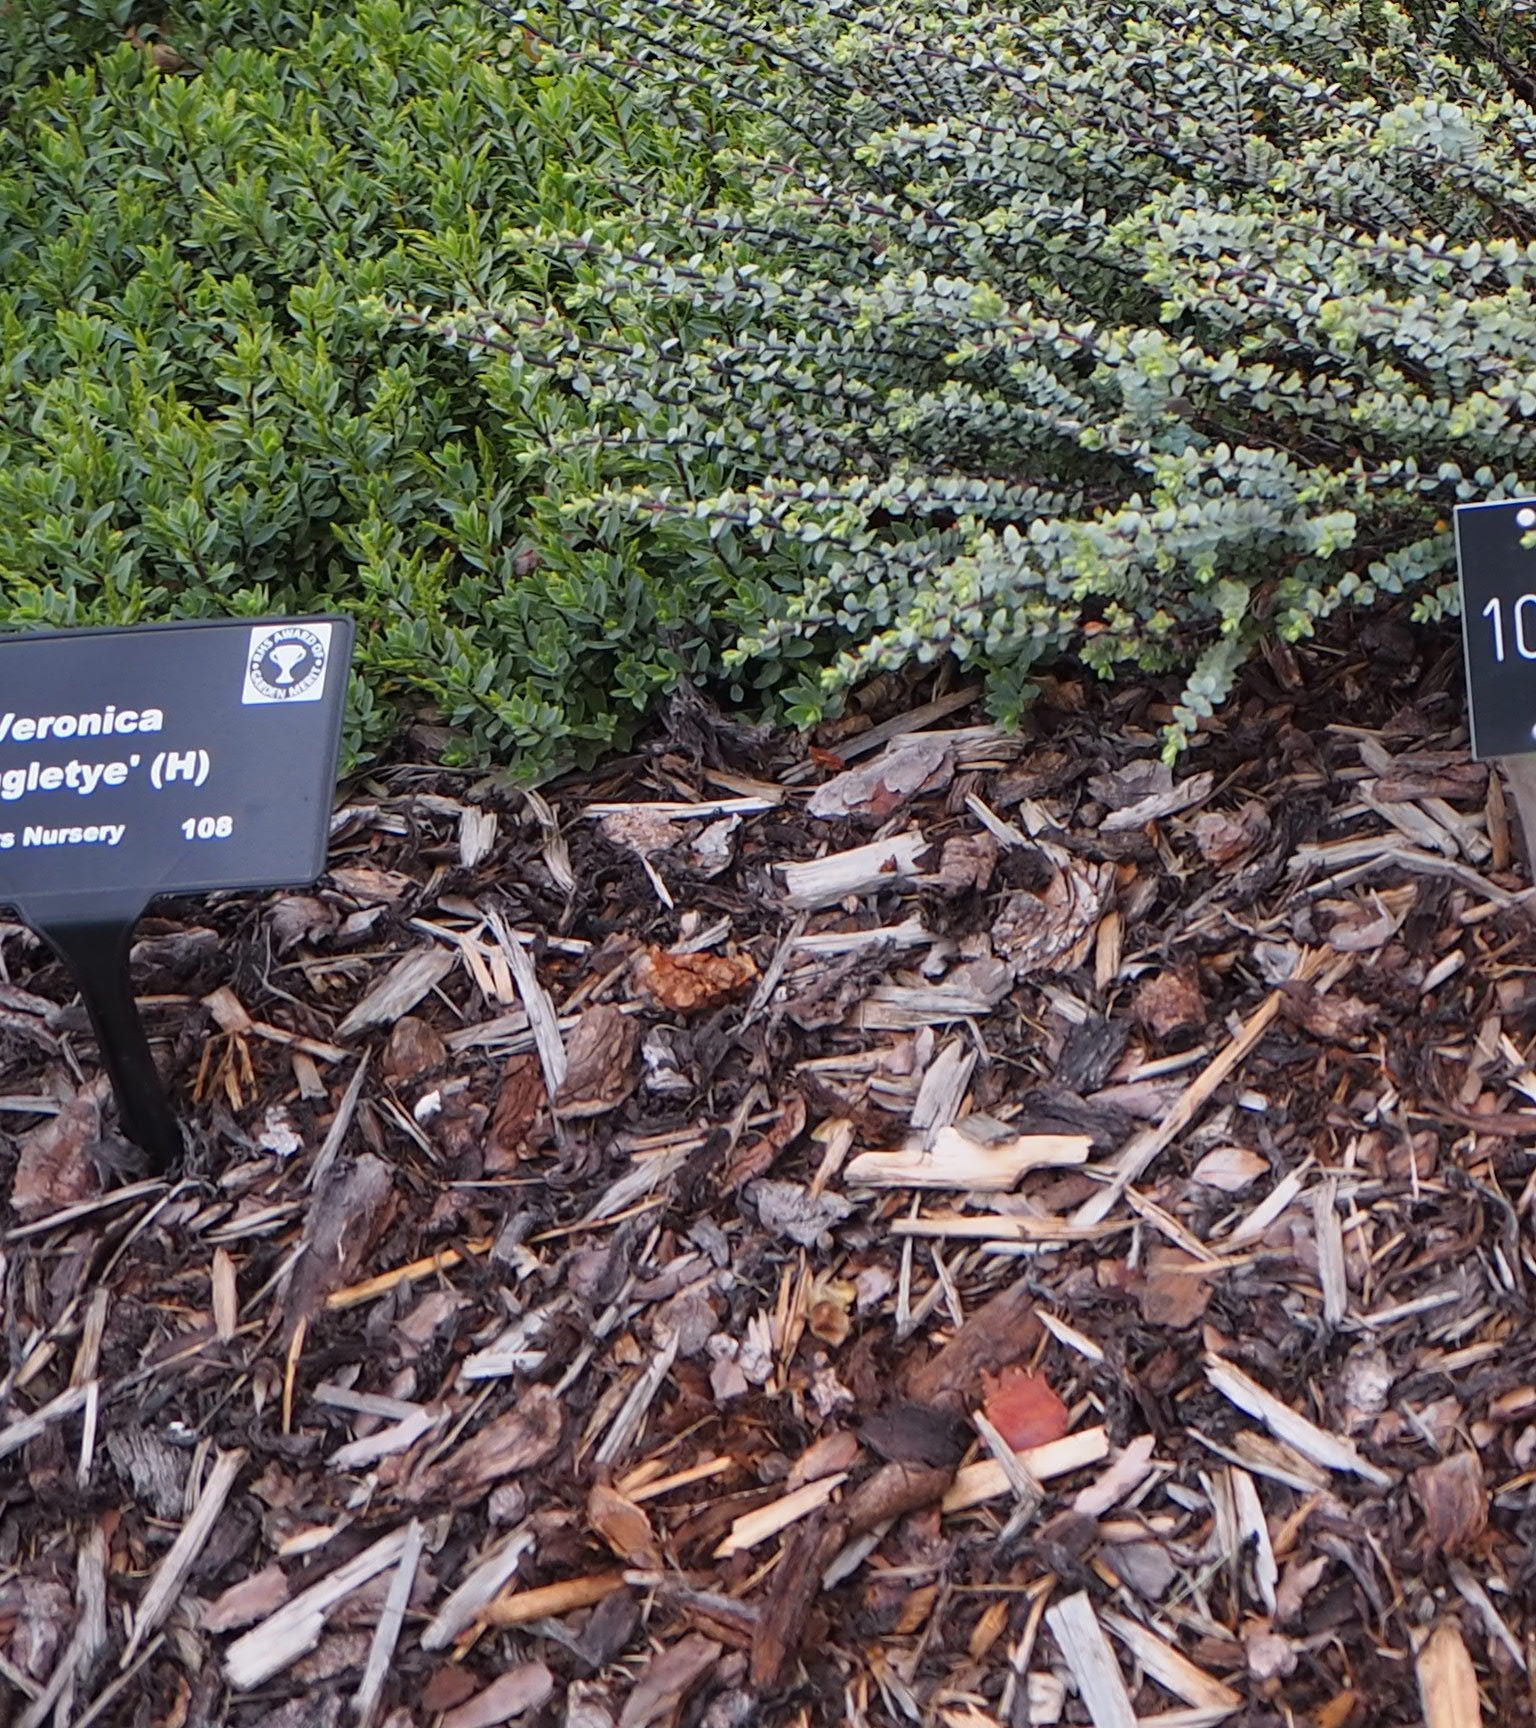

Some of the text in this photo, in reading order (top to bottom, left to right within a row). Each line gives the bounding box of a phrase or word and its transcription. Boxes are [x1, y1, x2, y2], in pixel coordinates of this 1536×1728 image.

[274, 629, 317, 646] AWARD
[0, 749, 210, 800] gletye' (H)
[22, 824, 125, 846] Nursery
[181, 816, 233, 840] 108
